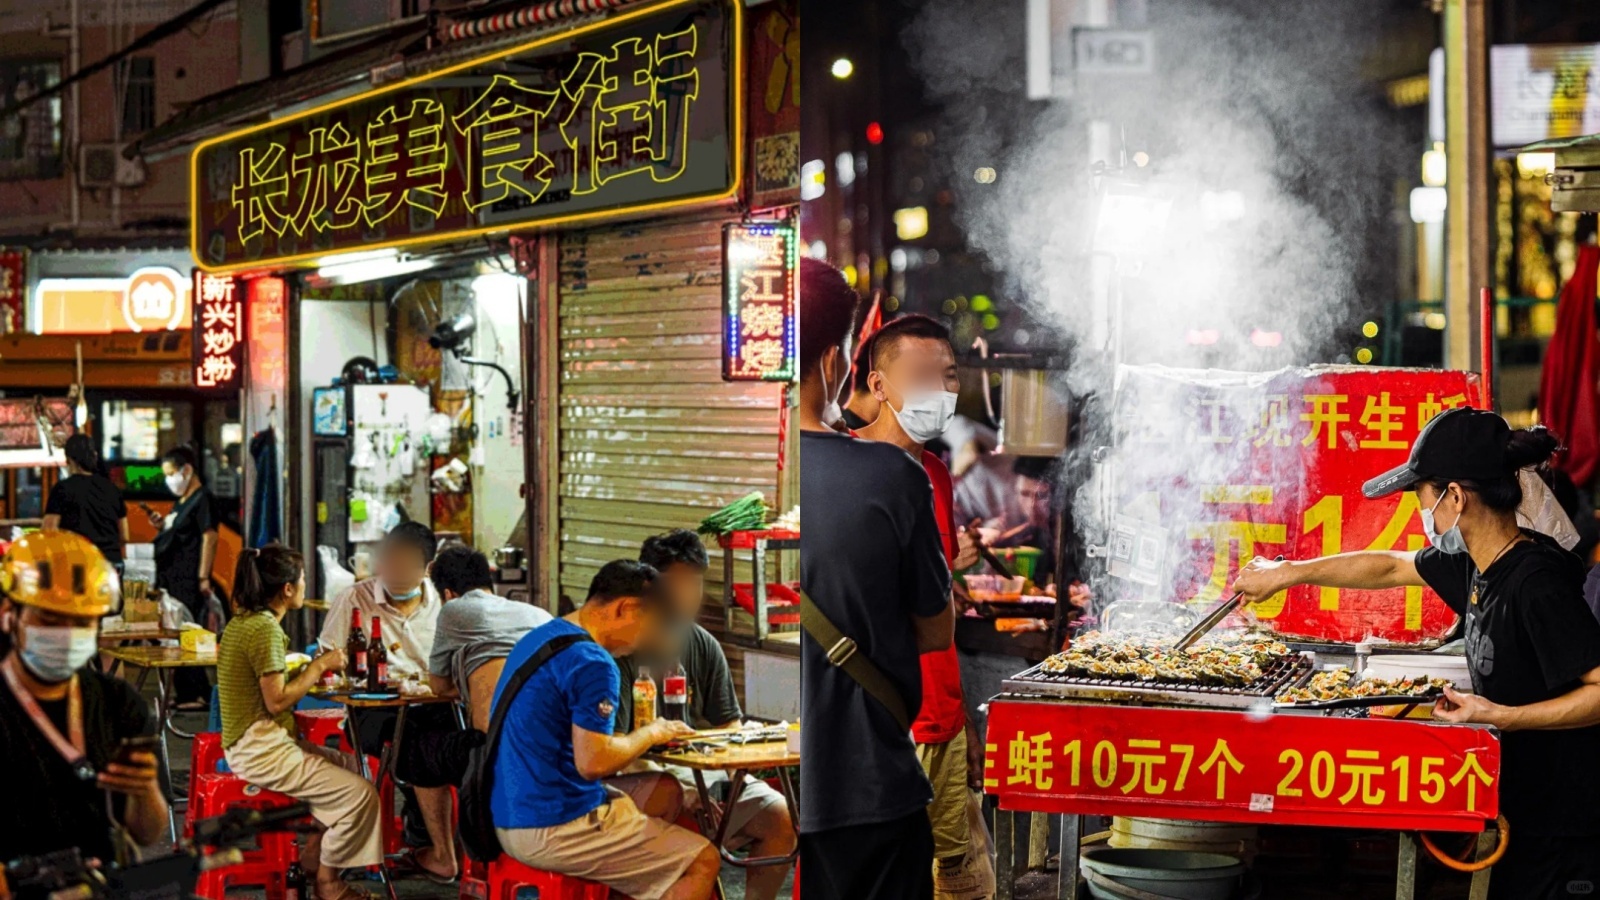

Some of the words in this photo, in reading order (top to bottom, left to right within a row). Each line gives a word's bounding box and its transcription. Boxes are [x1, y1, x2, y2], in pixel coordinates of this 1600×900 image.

[232, 24, 699, 246] 长龙美食街
[202, 275, 236, 381] 新兴炒粉
[1276, 749, 1495, 812] 20元15个
